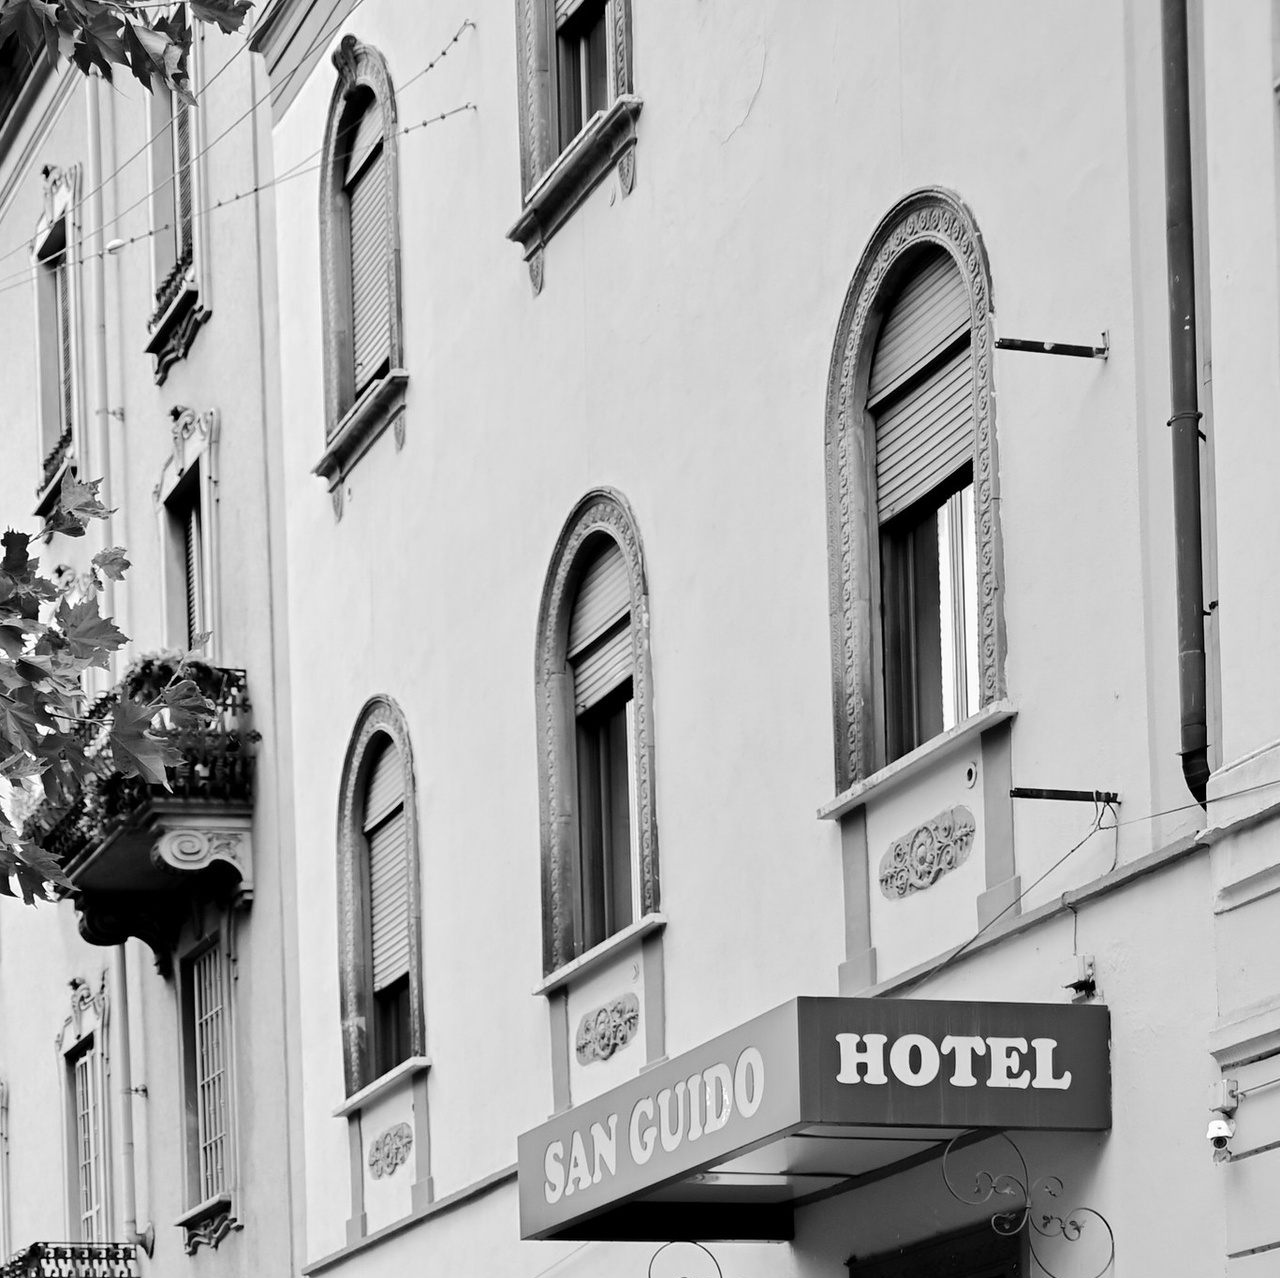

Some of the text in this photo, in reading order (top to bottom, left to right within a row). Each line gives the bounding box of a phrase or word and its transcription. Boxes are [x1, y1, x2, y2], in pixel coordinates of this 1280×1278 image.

[835, 1032, 1072, 1091] HOTEL
[543, 1046, 766, 1204] SAN GUIDO
